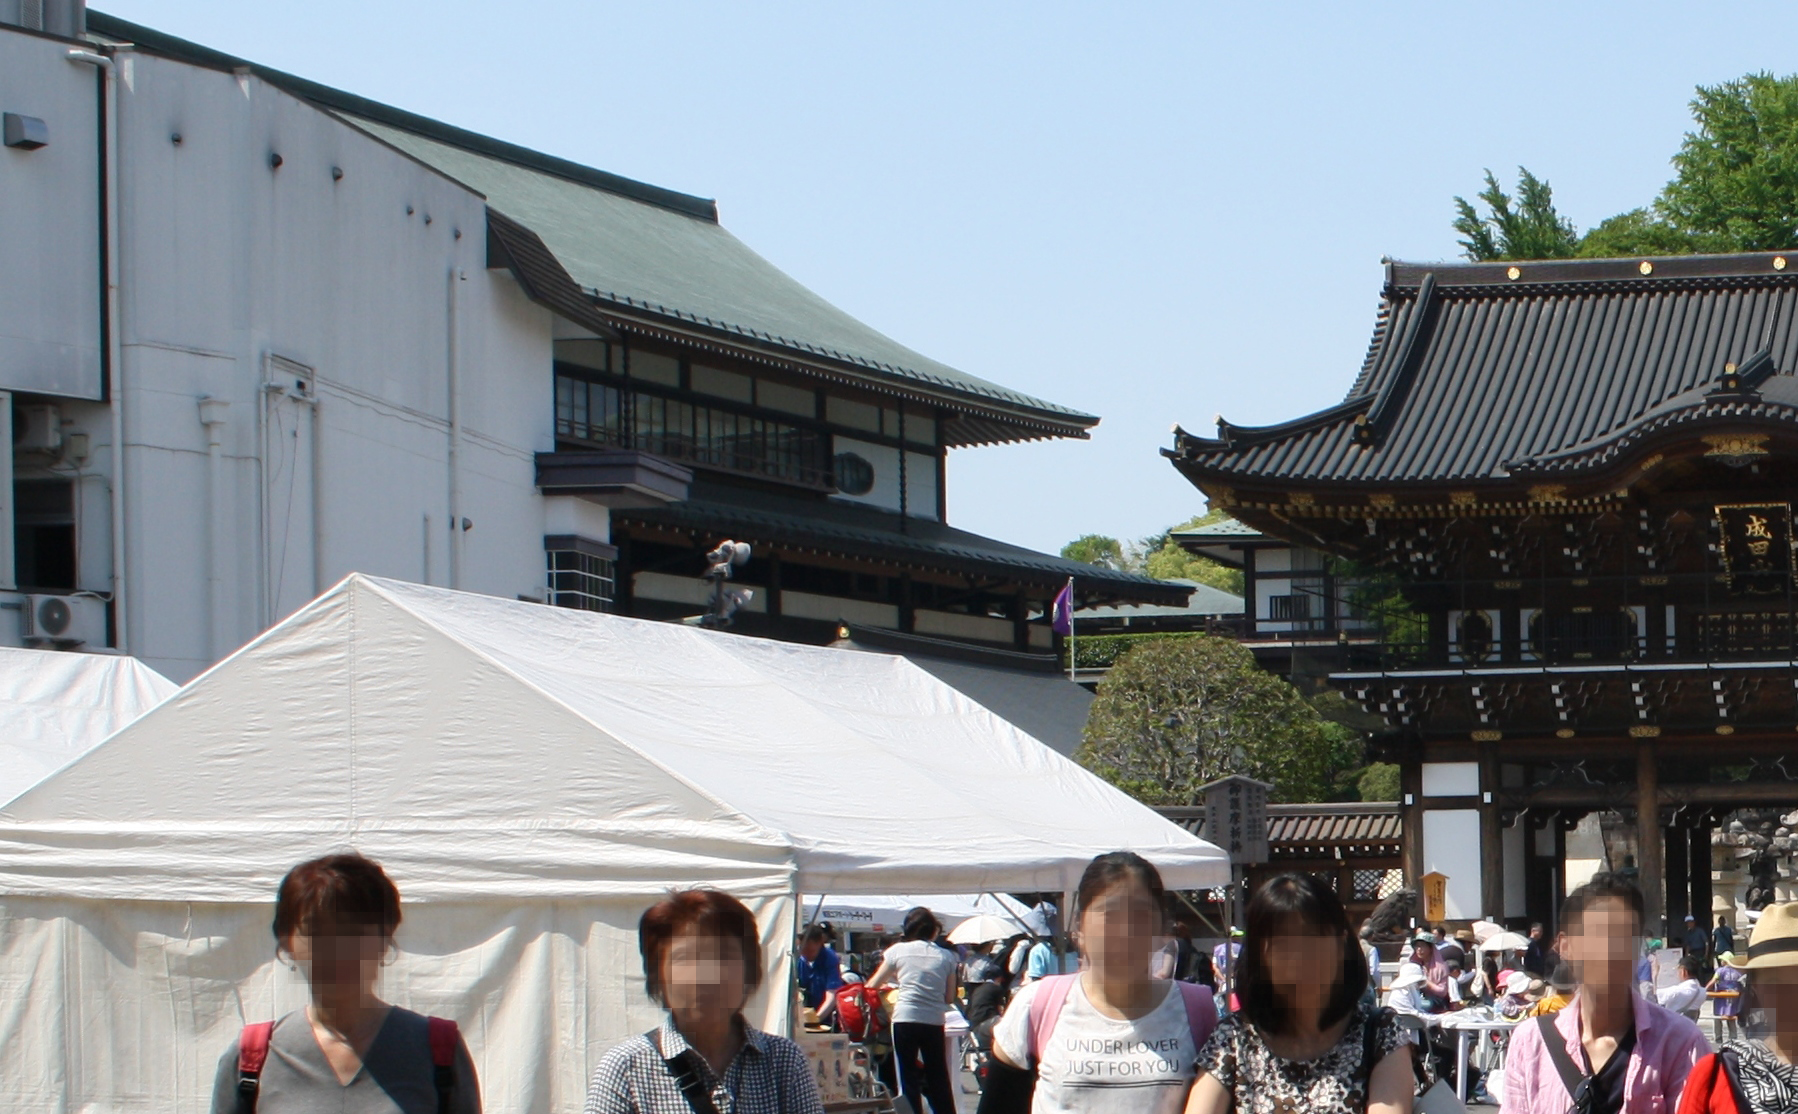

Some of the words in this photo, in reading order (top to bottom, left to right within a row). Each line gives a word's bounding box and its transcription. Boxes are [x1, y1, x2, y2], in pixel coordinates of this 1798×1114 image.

[1066, 1038, 1122, 1055] UNDER
[1127, 1037, 1180, 1054] LOVER
[1066, 1060, 1104, 1076] JUST
[1109, 1060, 1143, 1076] FOR
[1147, 1059, 1180, 1074] YOU
